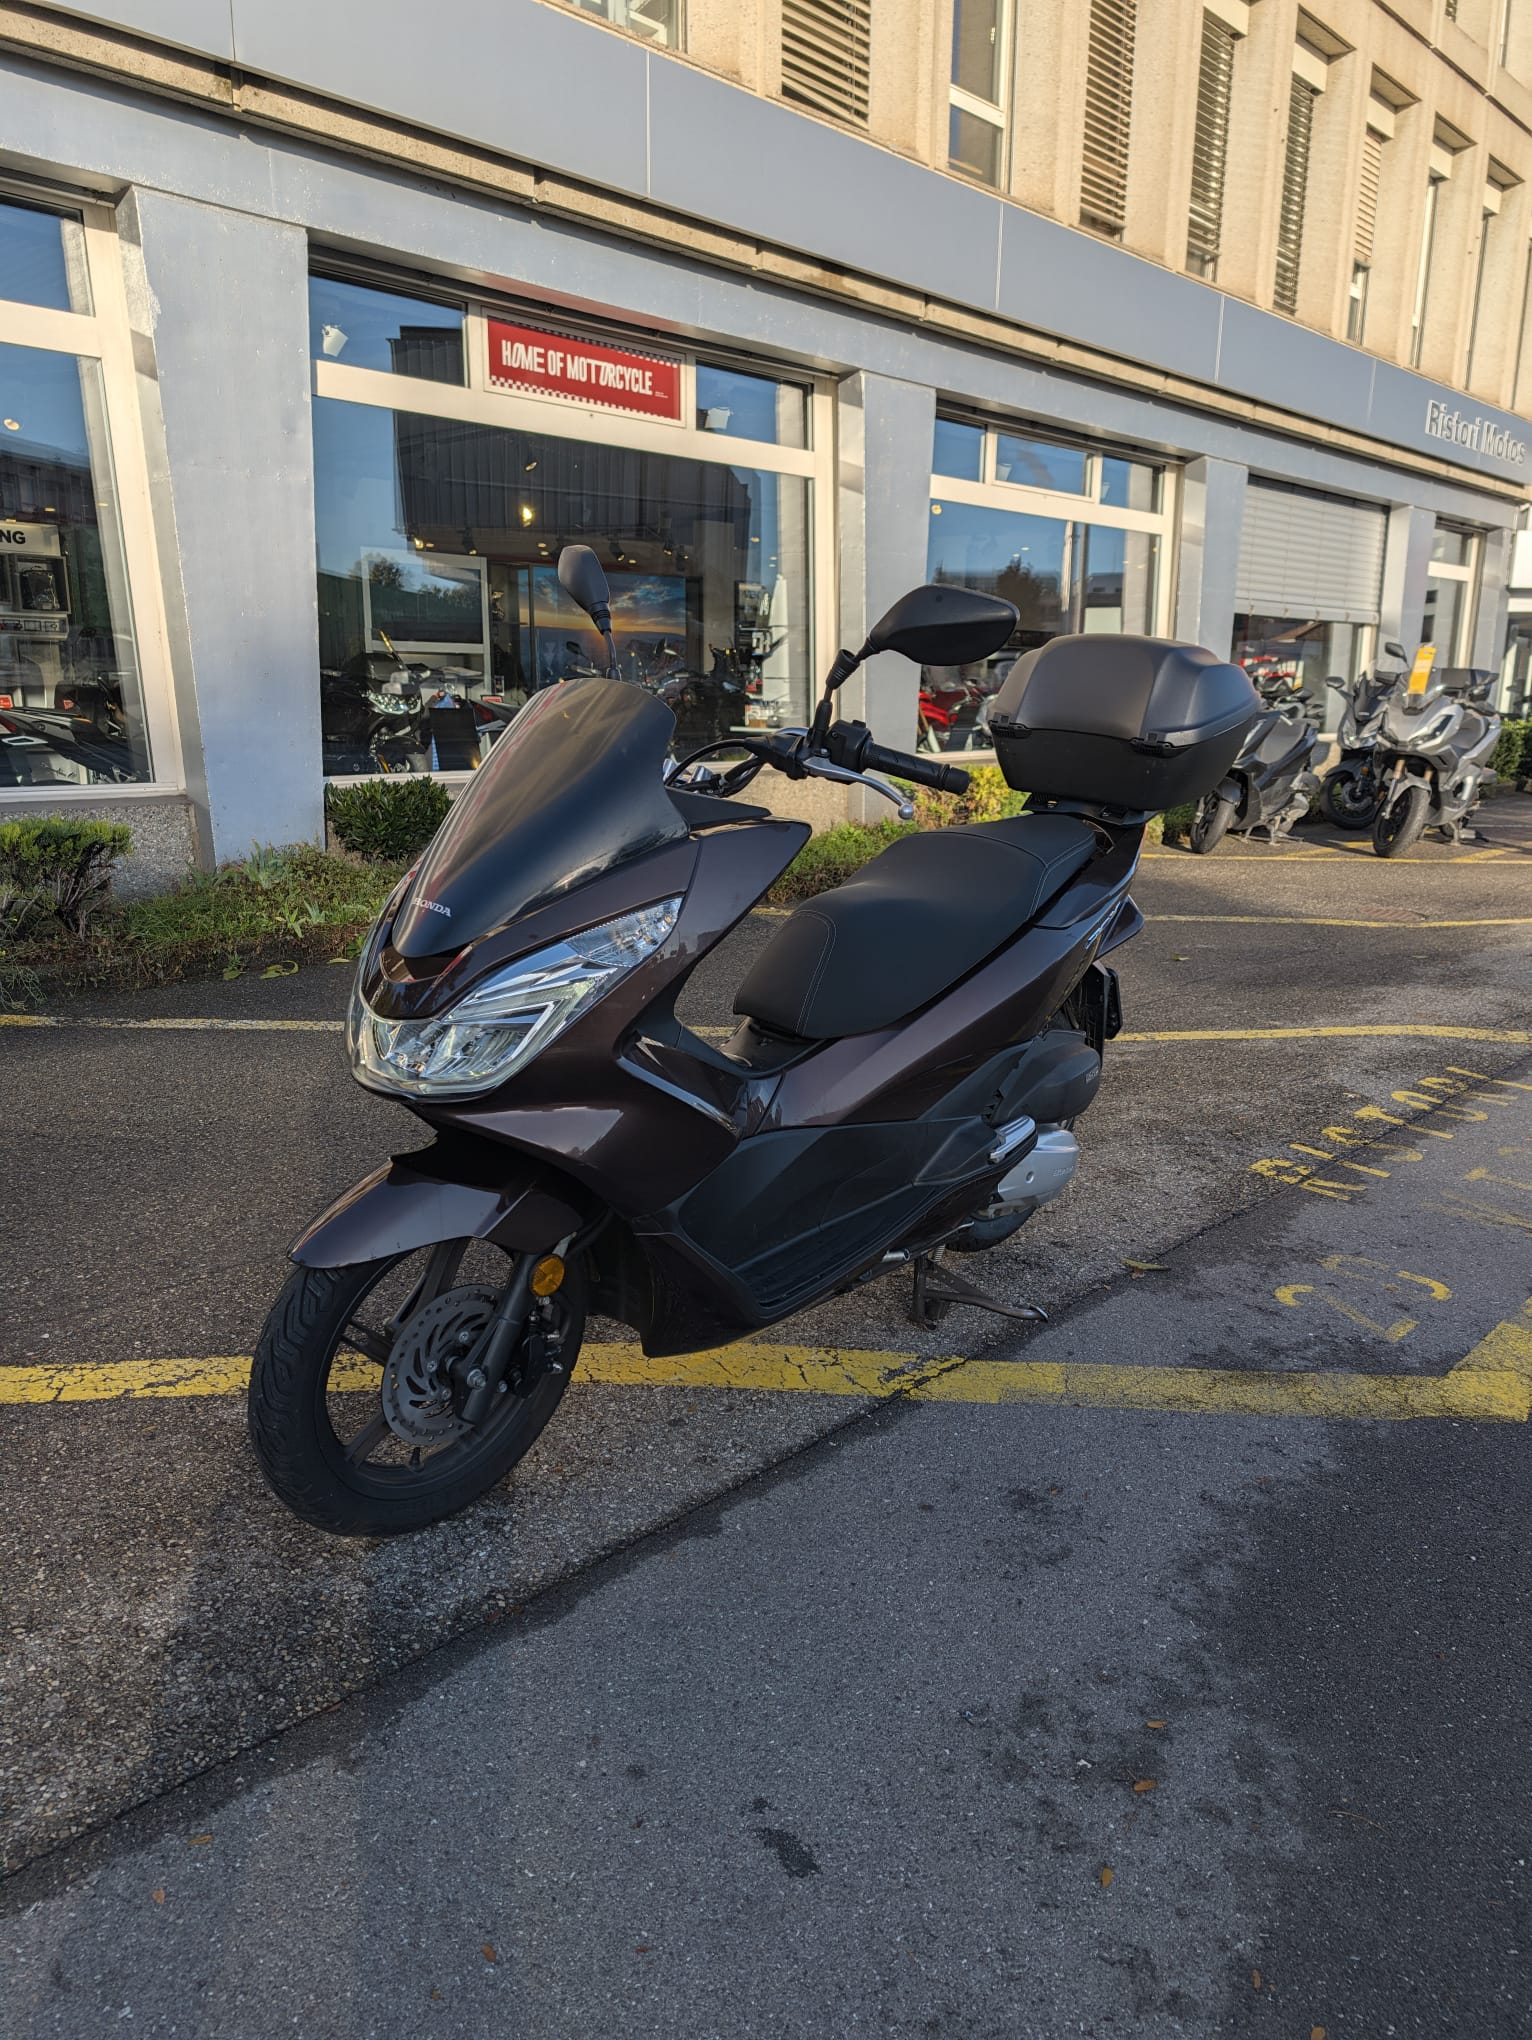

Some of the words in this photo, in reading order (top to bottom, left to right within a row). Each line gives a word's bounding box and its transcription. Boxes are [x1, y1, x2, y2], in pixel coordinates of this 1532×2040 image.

[501, 339, 545, 374] HOME
[547, 349, 565, 377] OF
[566, 353, 653, 395] MOTORCYCLE
[1424, 399, 1483, 452] Ristori
[1480, 420, 1527, 466] Motos
[412, 897, 452, 918] HONDA
[1249, 1066, 1532, 1200] RISTORI
